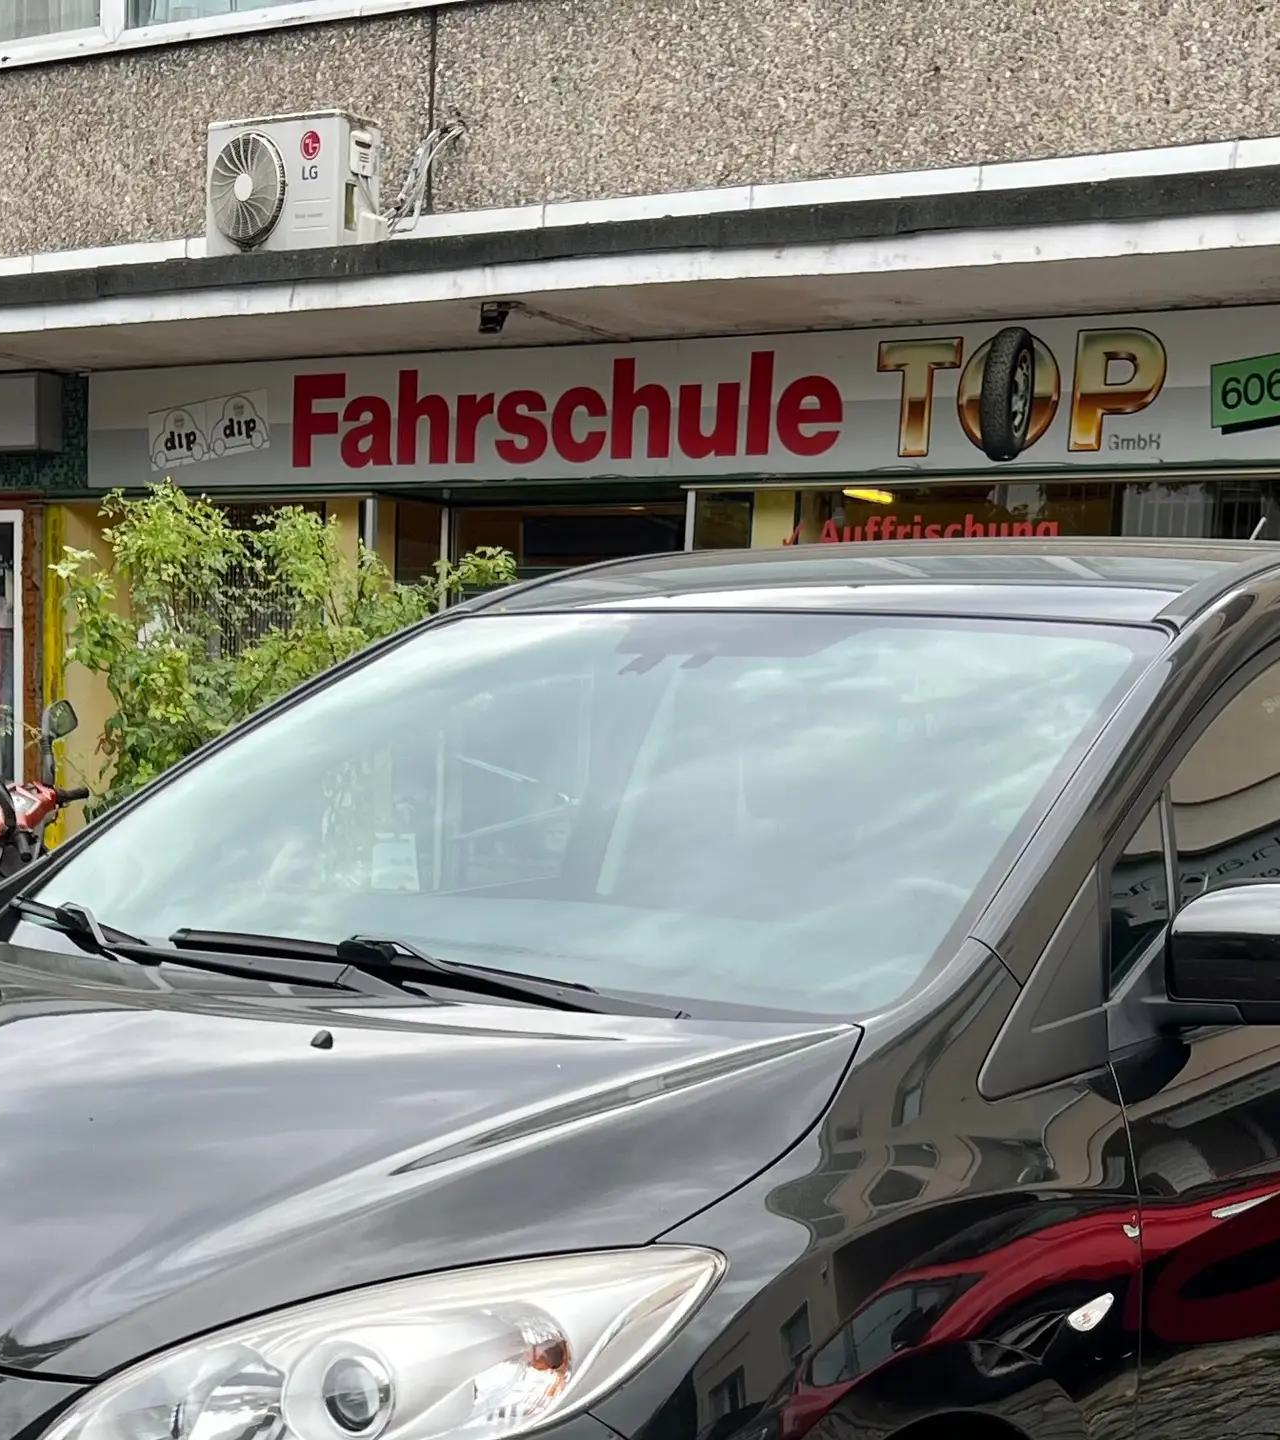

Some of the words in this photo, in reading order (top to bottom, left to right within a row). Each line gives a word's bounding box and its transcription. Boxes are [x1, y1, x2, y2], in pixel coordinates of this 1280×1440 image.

[301, 165, 318, 181] LG
[877, 327, 1168, 462] TOP
[291, 350, 844, 468] Fahrschule
[223, 417, 257, 439] dip
[164, 431, 197, 452] dip
